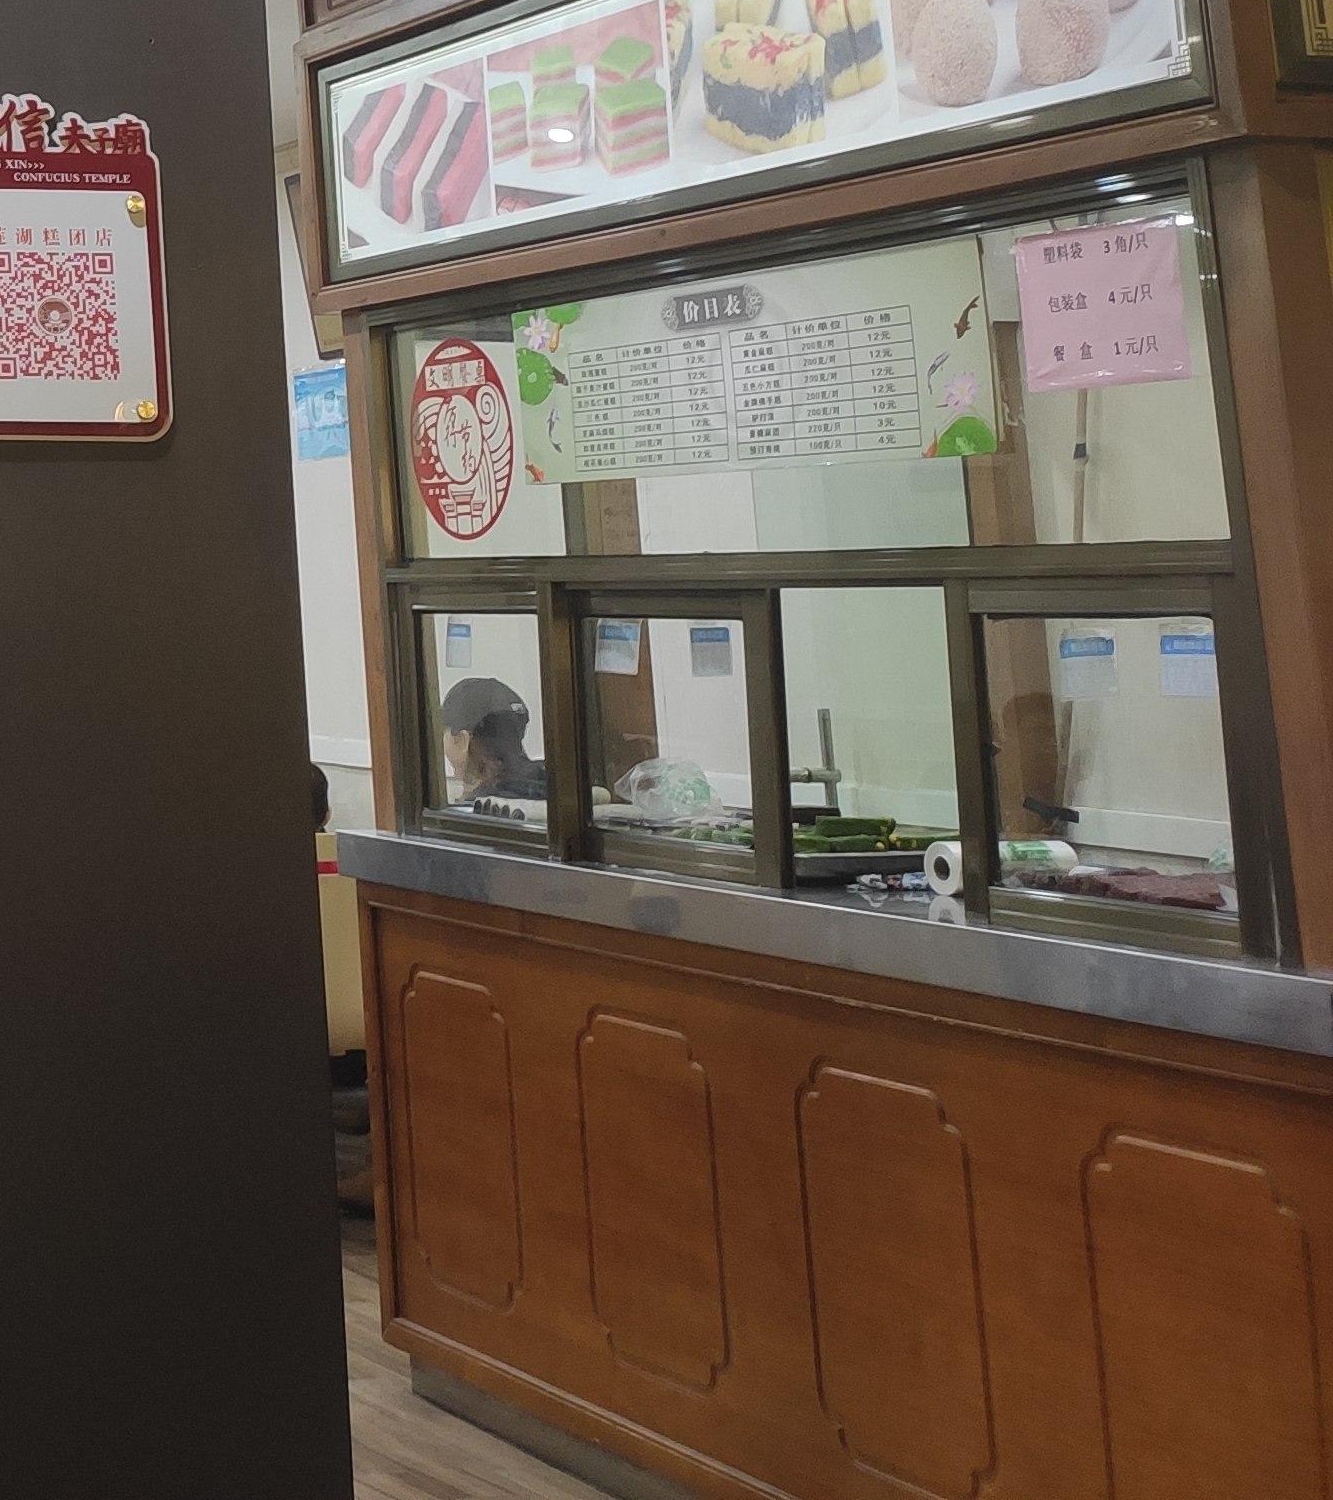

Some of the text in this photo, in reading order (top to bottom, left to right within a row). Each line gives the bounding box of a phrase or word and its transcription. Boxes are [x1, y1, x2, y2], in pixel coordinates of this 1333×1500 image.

[13, 172, 131, 184] CONFUCIUS TEMPLE
[1043, 241, 1084, 264] 塑料袋
[683, 294, 742, 323] 价目表
[1048, 283, 1153, 313] 包装盒 4元/只
[1113, 335, 1160, 356] 1元/只
